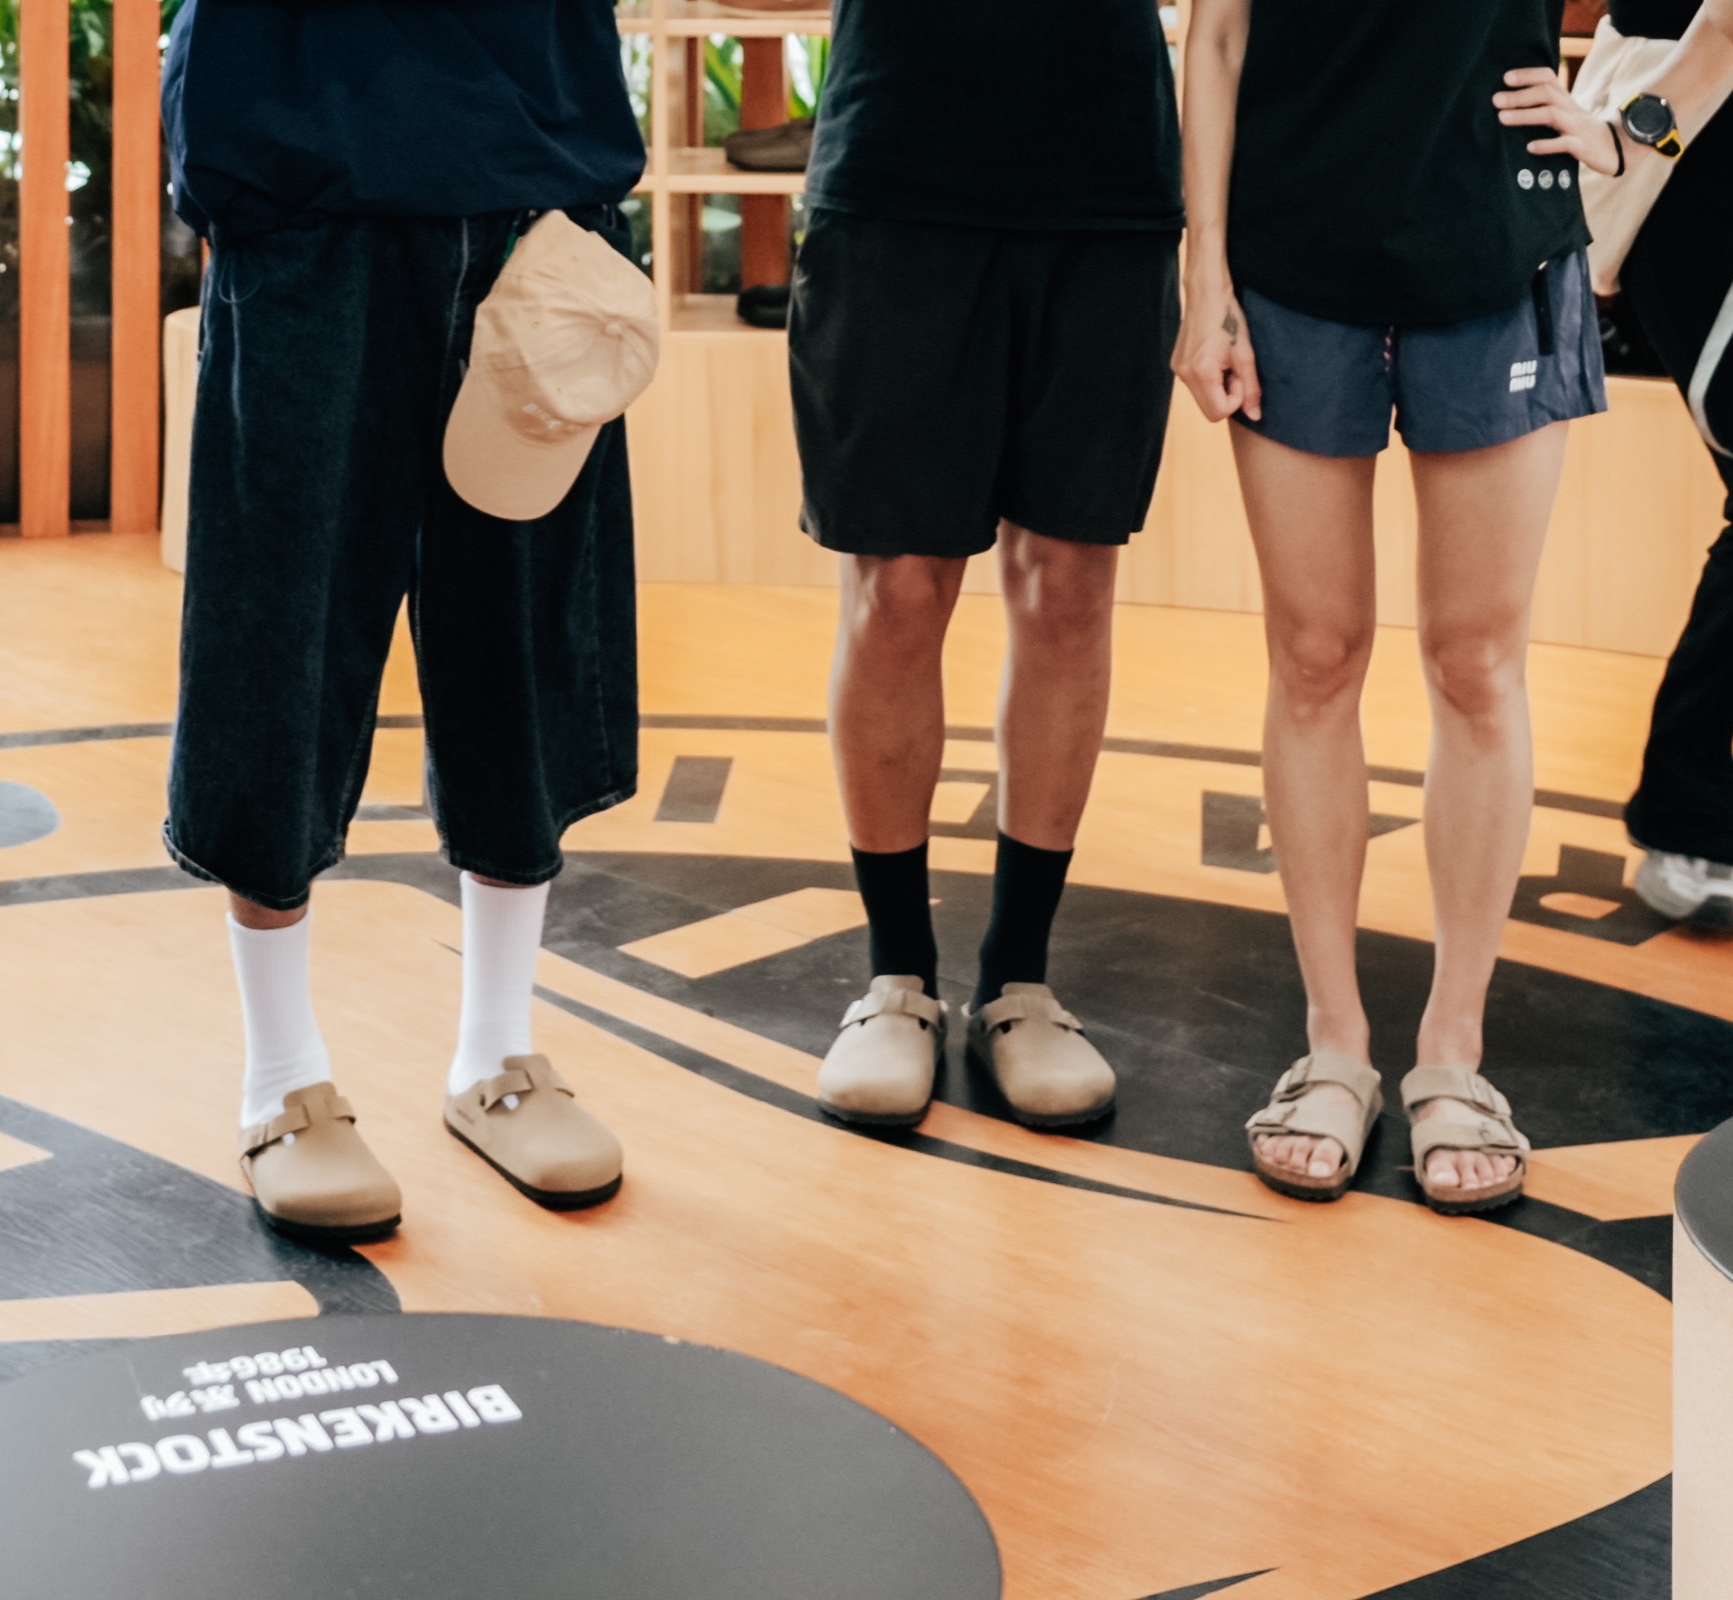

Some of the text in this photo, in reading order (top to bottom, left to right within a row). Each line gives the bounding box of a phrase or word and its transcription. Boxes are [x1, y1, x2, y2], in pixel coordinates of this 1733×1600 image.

[139, 1359, 399, 1422] LONDON 系列
[182, 1345, 328, 1386] 1986年
[72, 1384, 524, 1490] BIRKENSTOCK
